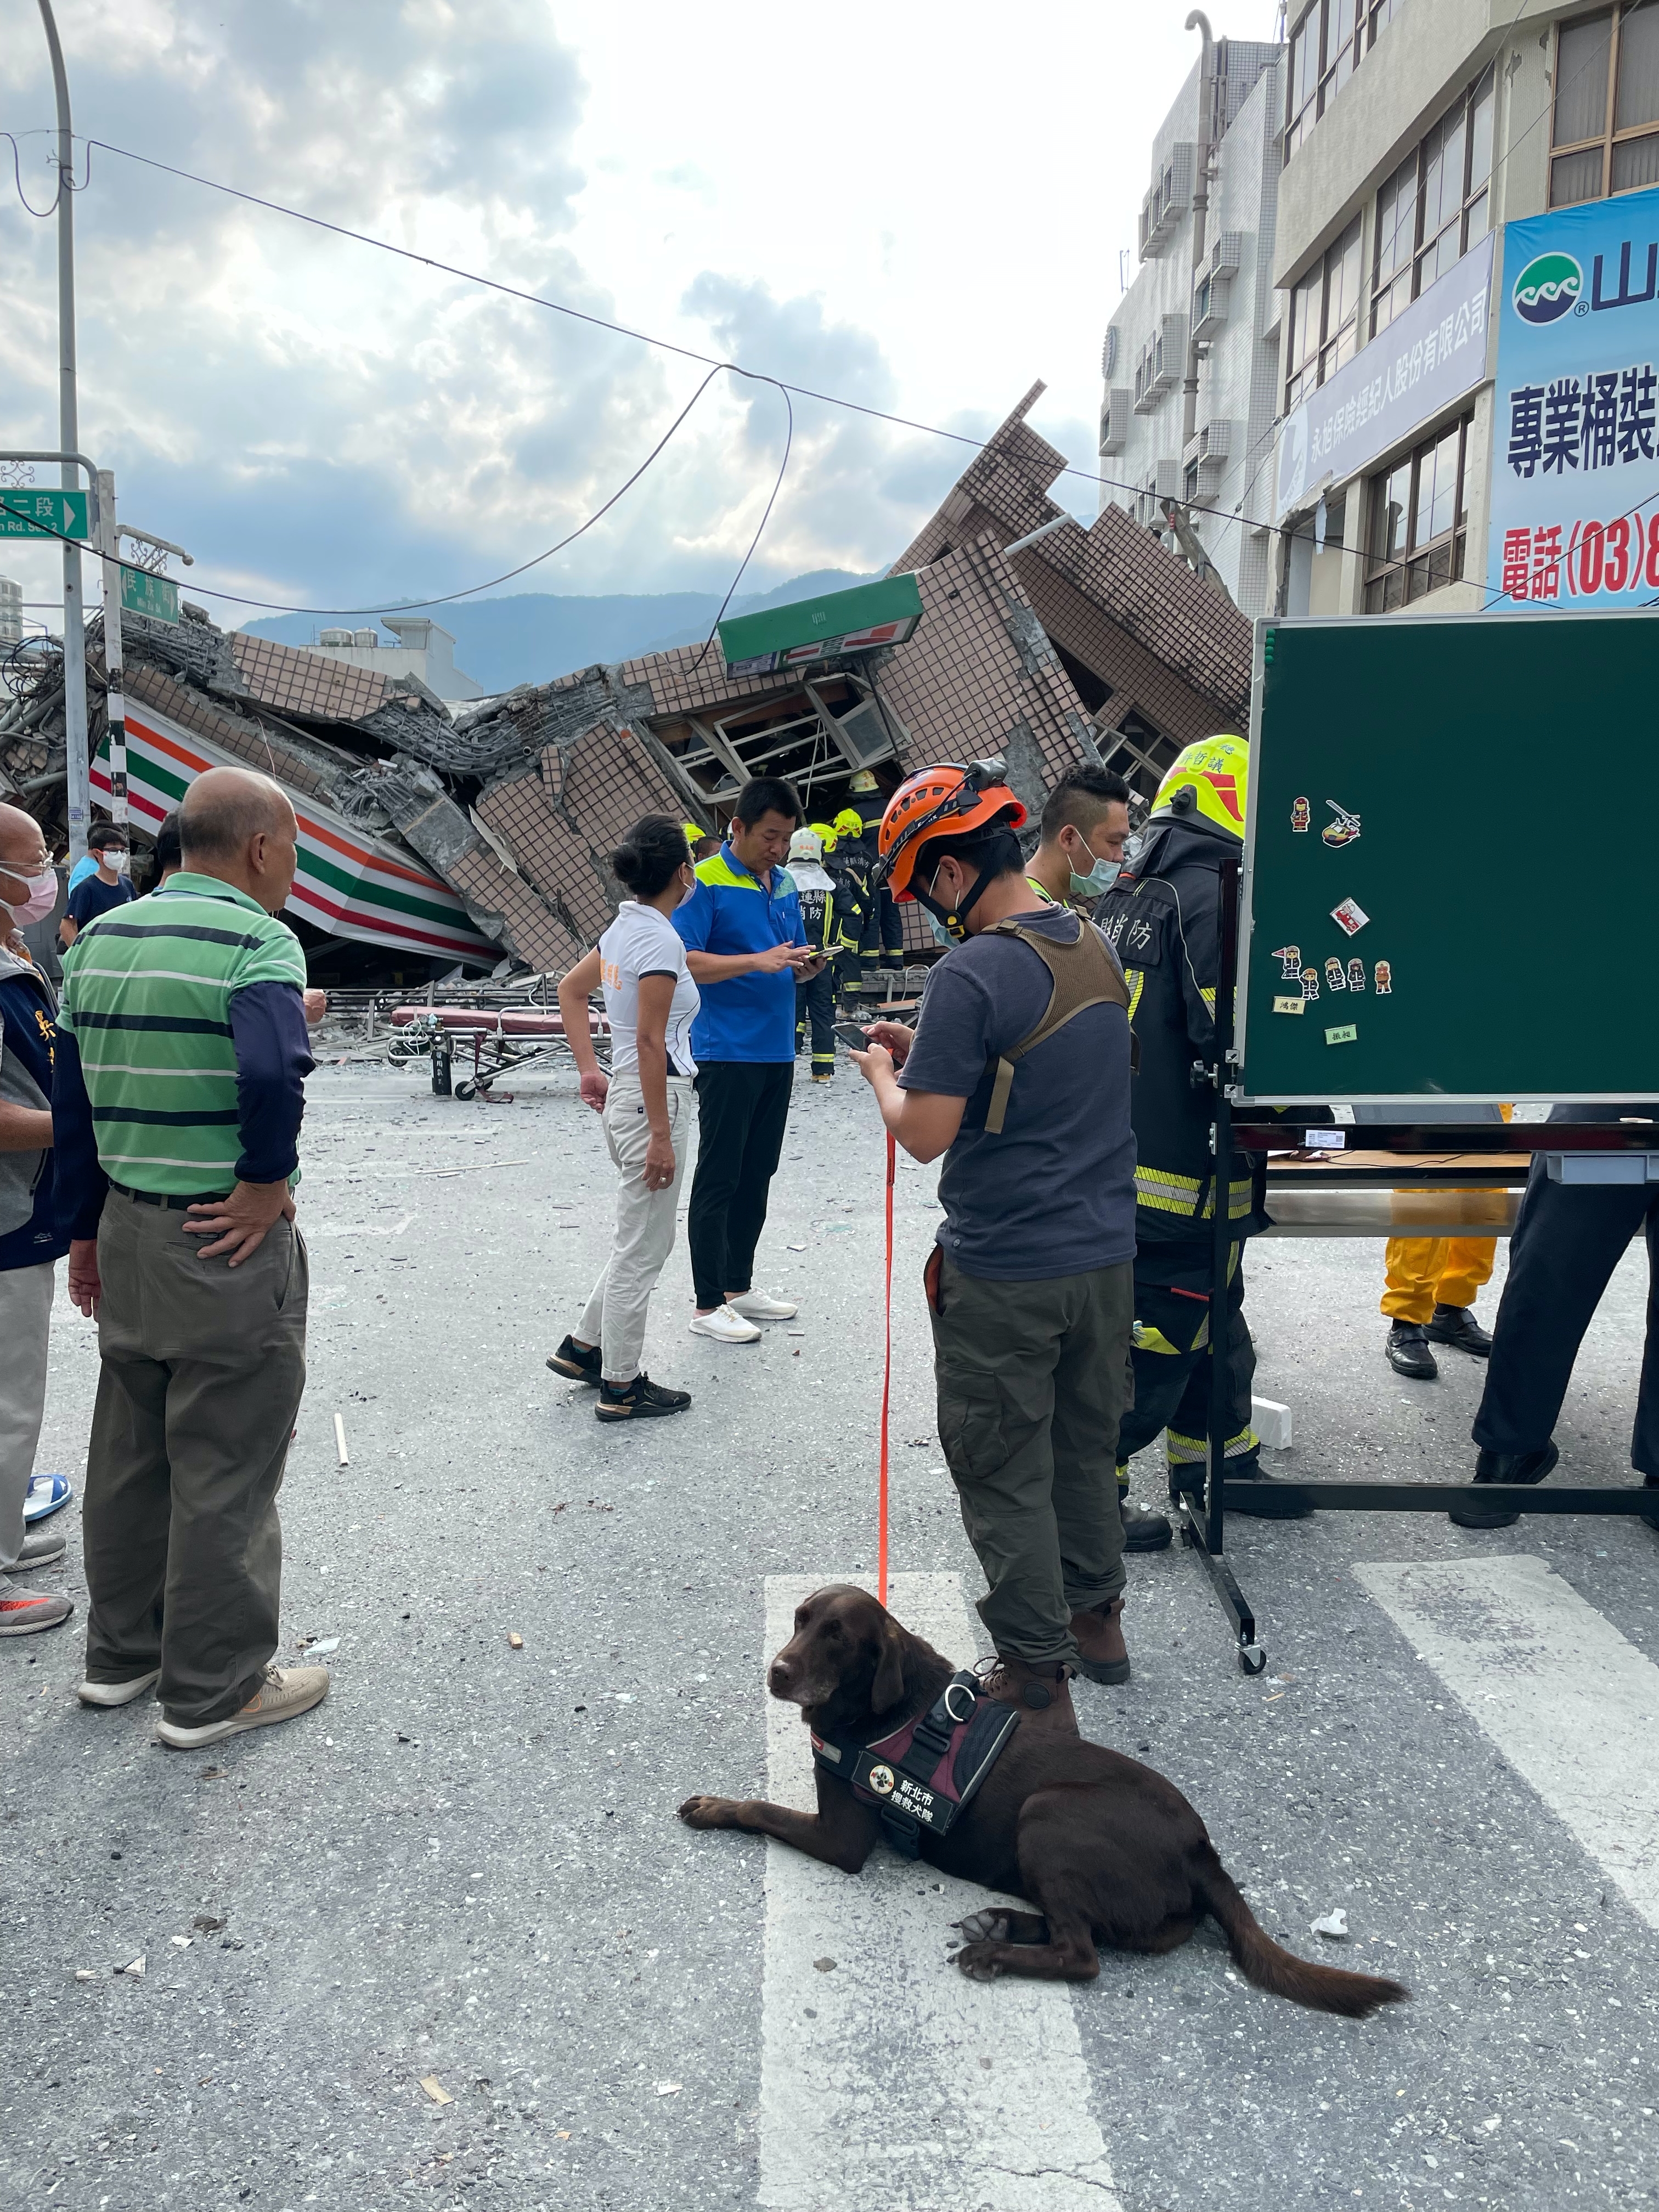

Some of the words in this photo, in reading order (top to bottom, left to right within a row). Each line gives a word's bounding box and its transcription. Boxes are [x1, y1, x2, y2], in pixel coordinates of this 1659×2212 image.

[1592, 241, 1659, 311] 山
[1311, 286, 1487, 464] 永旭保險經紀人股份有限公司
[1508, 365, 1659, 478] 專業桶裝
[8, 521, 26, 532] Rd.
[127, 568, 170, 604] 民族街
[147, 600, 154, 612] Zu
[1091, 913, 1153, 950] 縣消防
[890, 1790, 934, 1822] 搜救犬隊
[900, 1780, 934, 1806] 新北市
